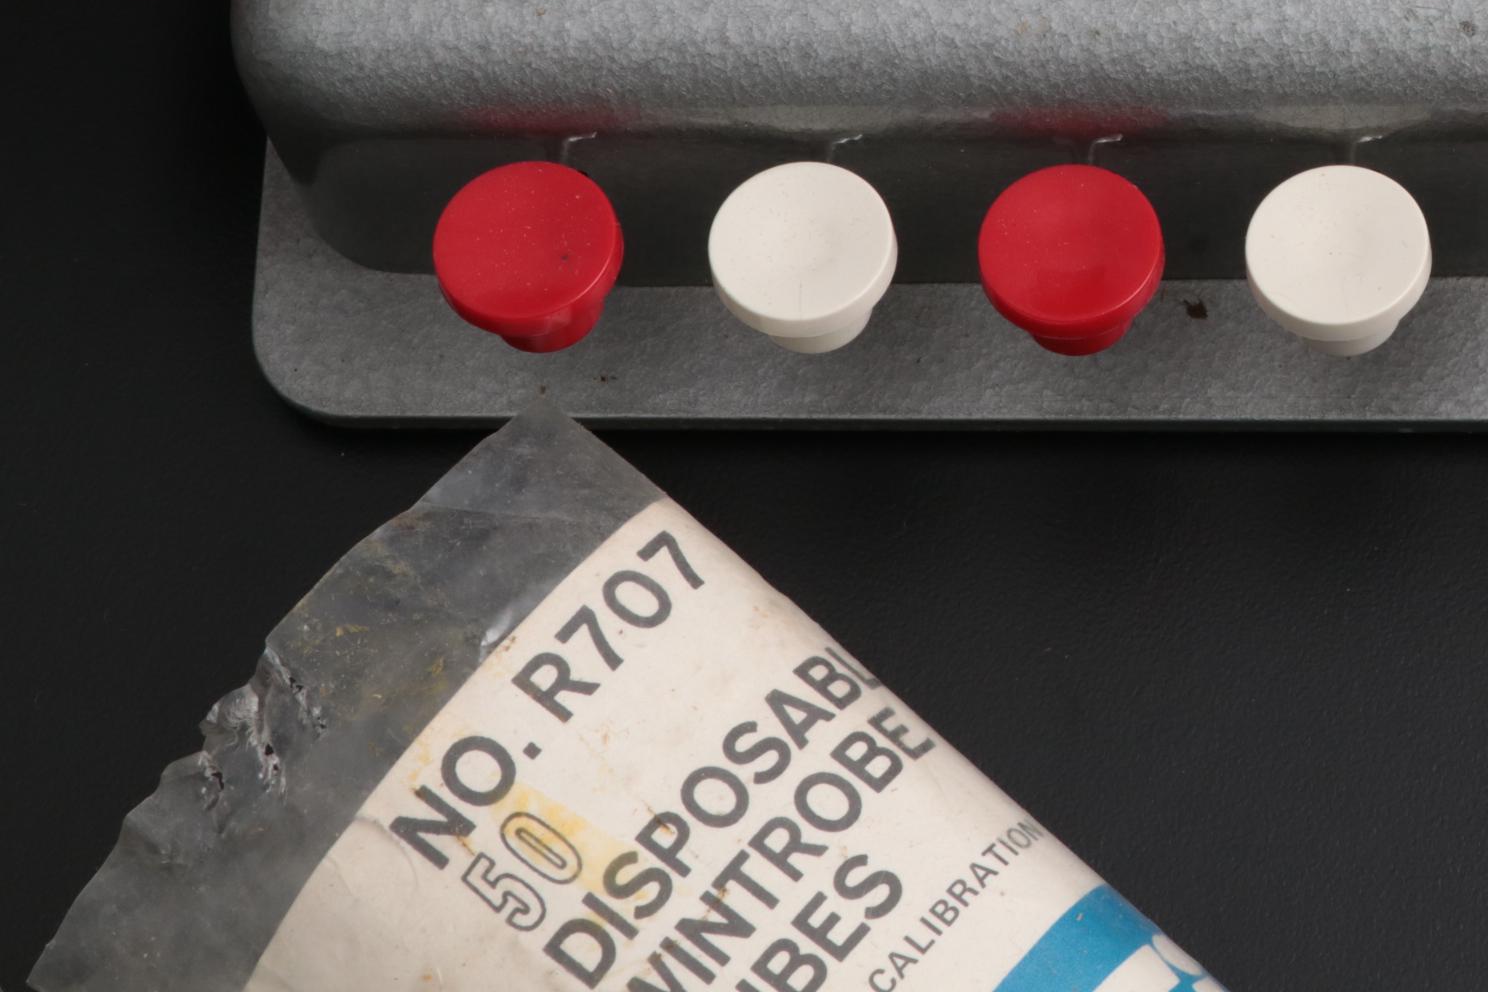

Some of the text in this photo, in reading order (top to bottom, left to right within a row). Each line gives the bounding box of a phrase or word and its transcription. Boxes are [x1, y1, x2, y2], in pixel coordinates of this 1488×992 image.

[390, 530, 704, 869] NO. R707
[543, 647, 883, 990] DISPOSABL
[461, 812, 582, 931] 50
[735, 854, 902, 992] BES
